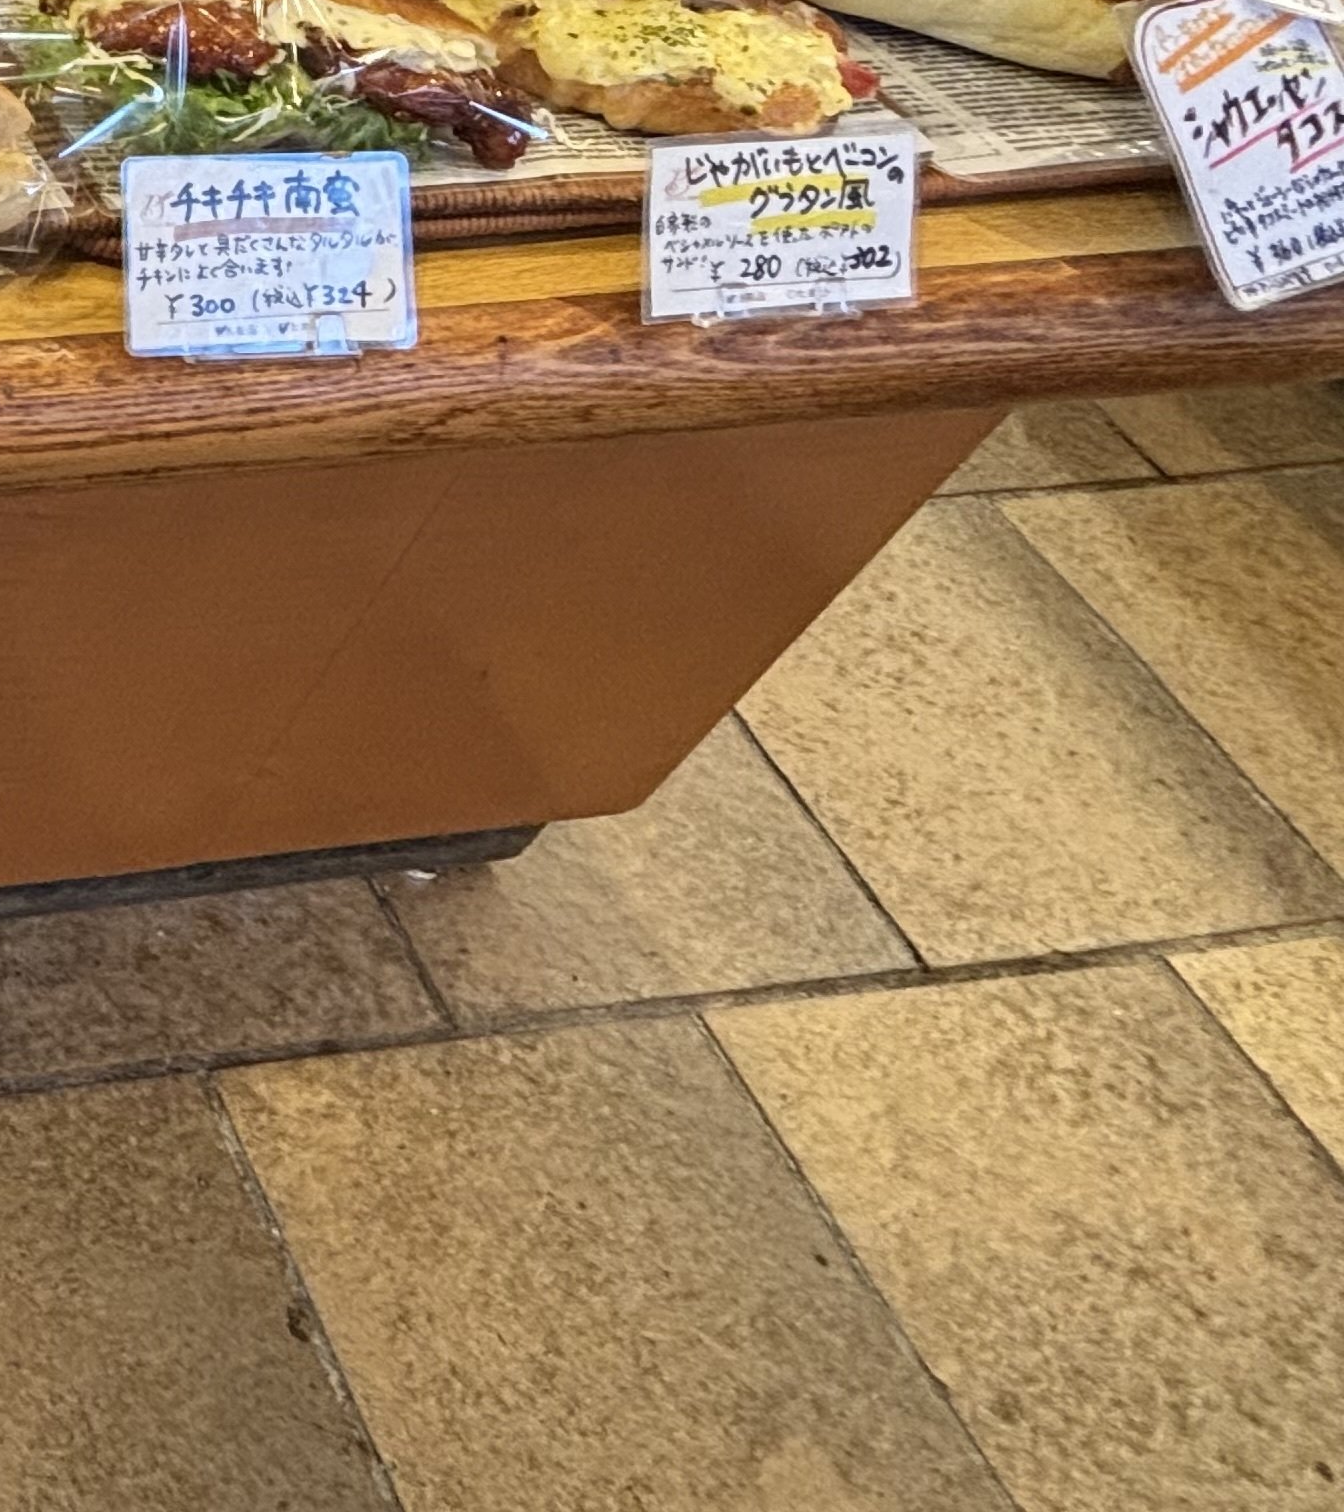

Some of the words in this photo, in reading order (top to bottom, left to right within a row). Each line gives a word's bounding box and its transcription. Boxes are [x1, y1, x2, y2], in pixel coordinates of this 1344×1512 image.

[685, 141, 905, 188] じゃがいもとベーコンの
[170, 169, 361, 224] チキチキ南蛮
[749, 178, 876, 219] グラタン風
